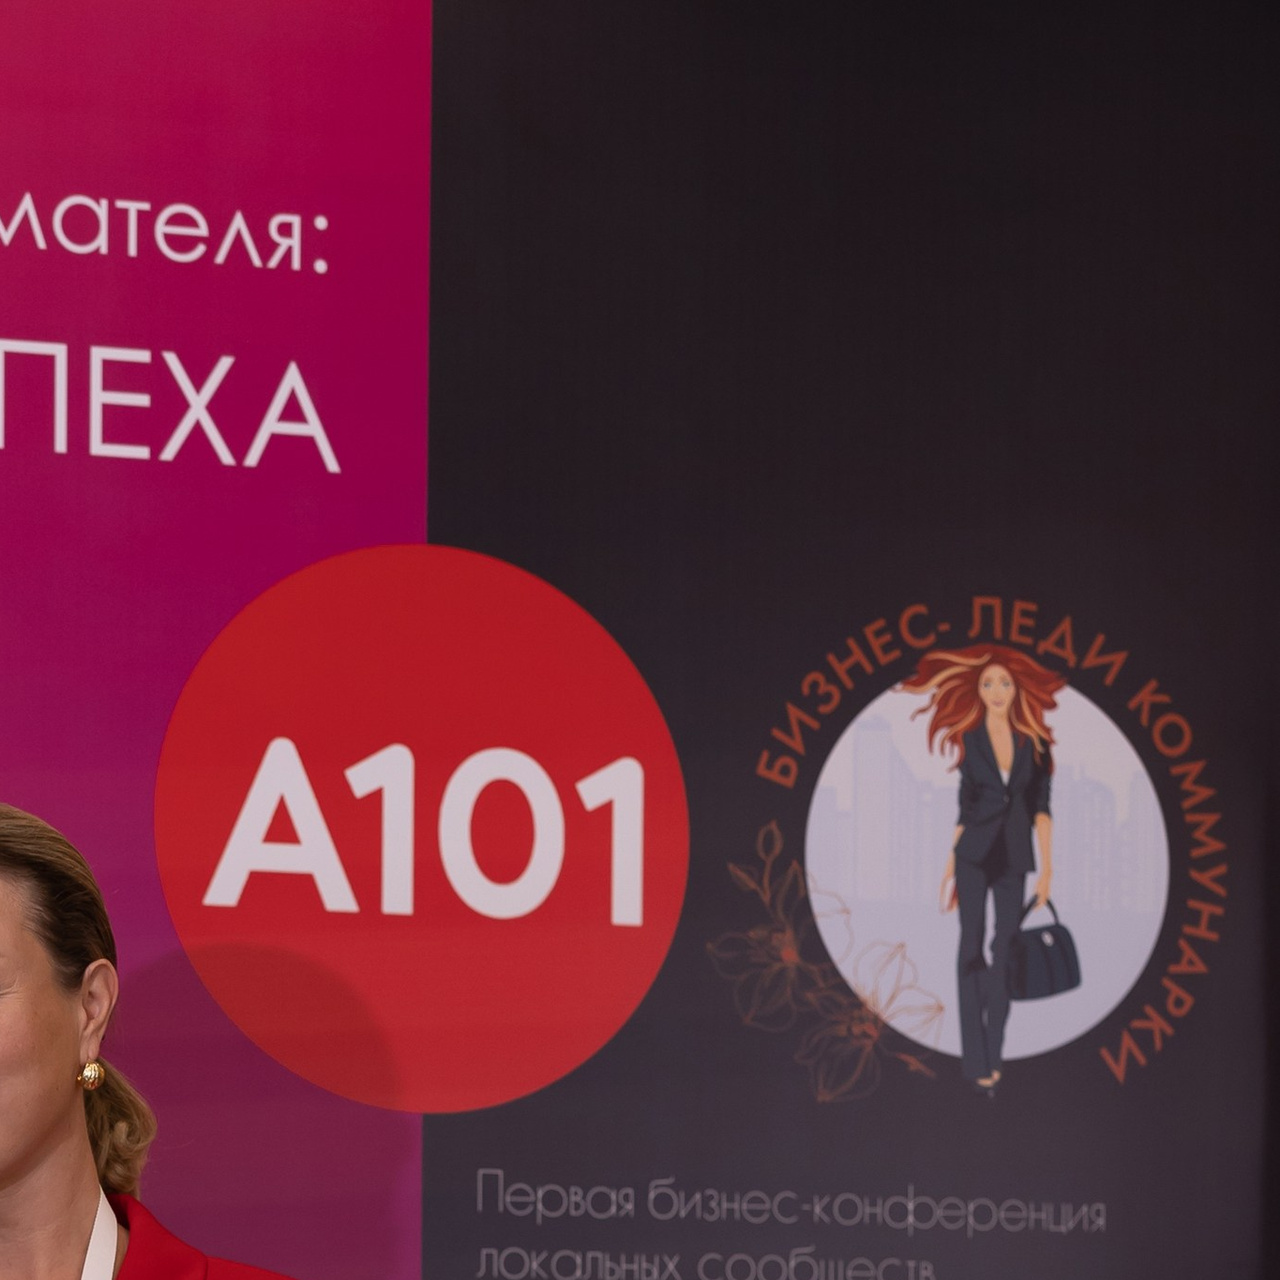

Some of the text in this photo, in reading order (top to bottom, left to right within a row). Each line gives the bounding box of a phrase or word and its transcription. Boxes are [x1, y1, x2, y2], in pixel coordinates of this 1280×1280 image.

[968, 596, 1129, 687] ЛЕДИ
[1099, 679, 1229, 1085] КОММУНАРКИ
[476, 1168, 1108, 1239] Первая бизнес-конференция
